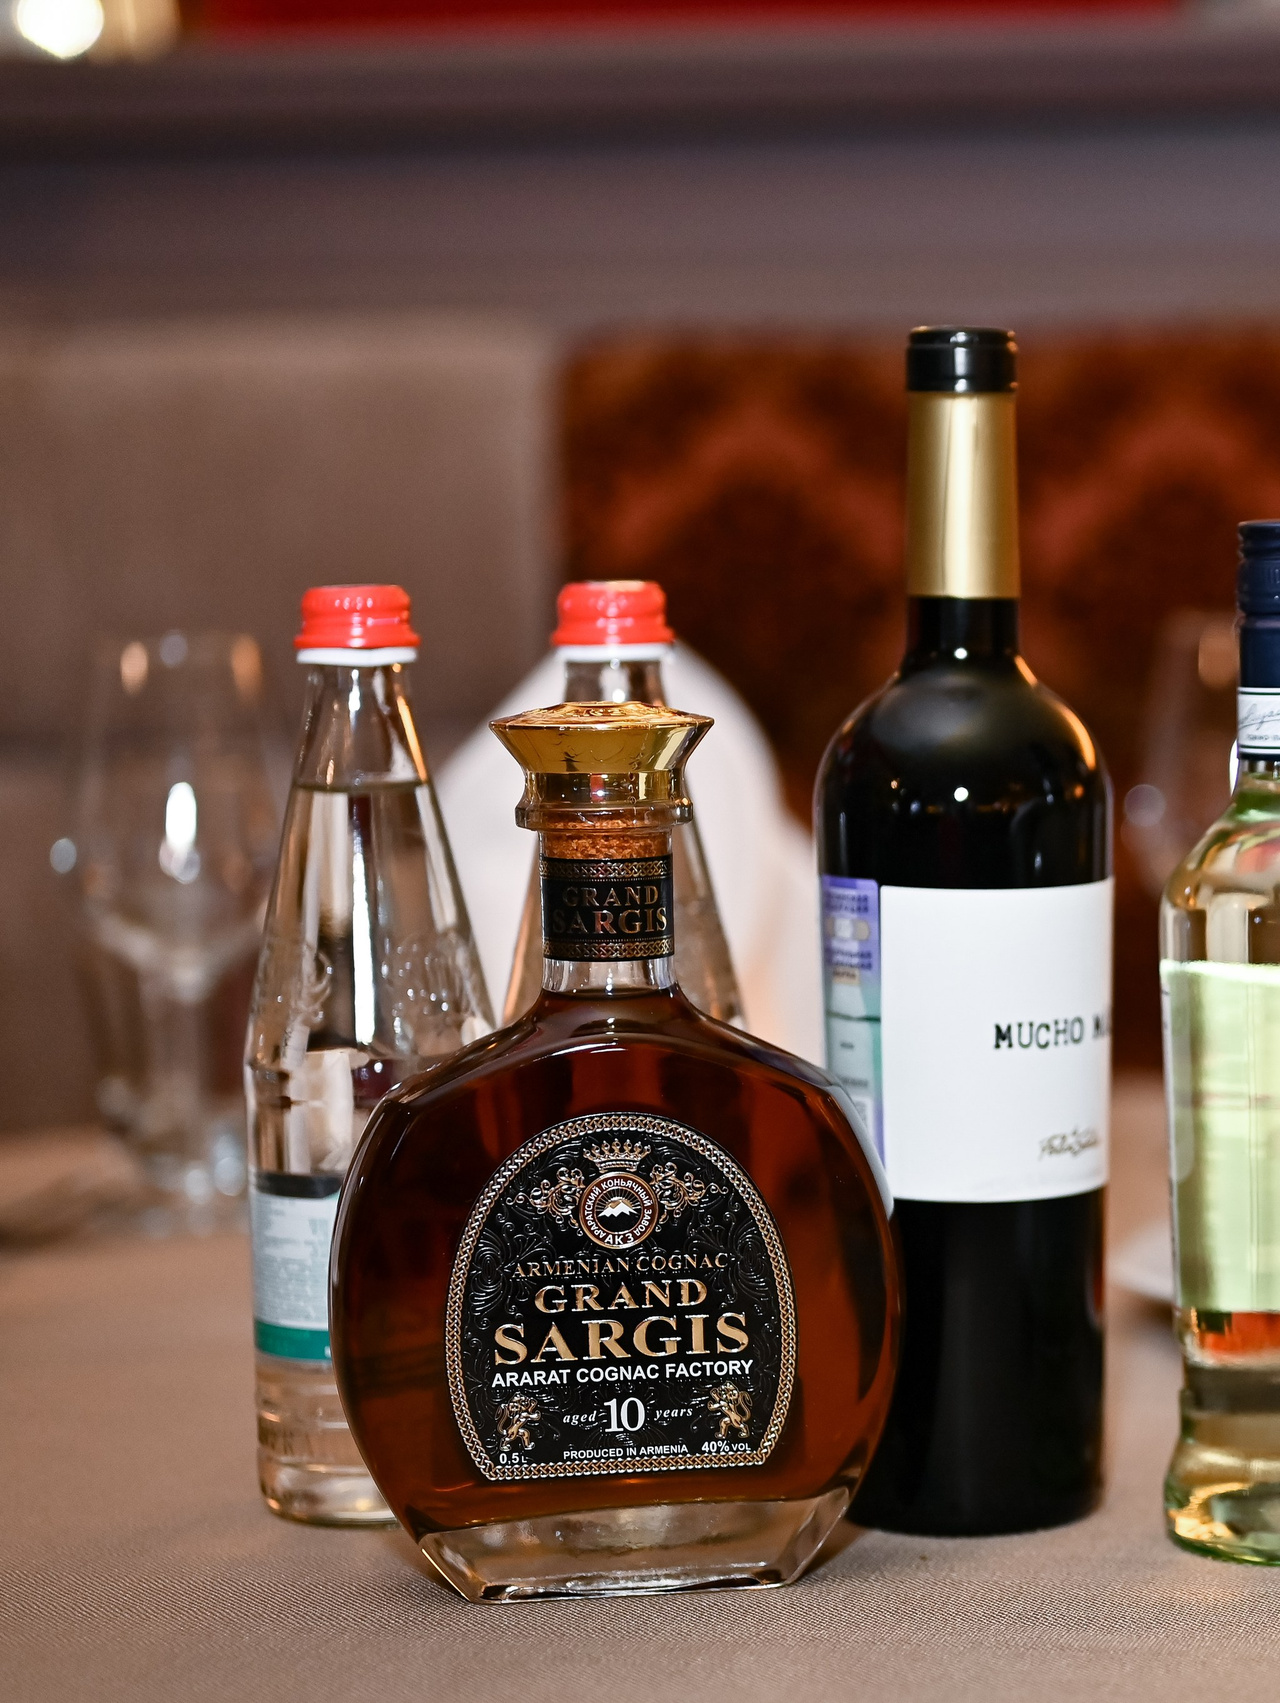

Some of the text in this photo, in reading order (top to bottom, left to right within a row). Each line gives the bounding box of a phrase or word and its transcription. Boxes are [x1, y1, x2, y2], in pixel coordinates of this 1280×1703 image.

[562, 885, 659, 907] GRAND
[552, 906, 667, 934] SARGIS
[994, 1016, 1084, 1049] MUCHO
[584, 1178, 653, 1239] АРАРАТСКИЙ КОНЬЯЧНЫЙ ЗАВОД
[511, 1252, 729, 1279] ARMENIAN COGNAC
[534, 1278, 708, 1314] GRAND
[494, 1311, 750, 1366] SARGIS
[491, 1359, 754, 1388] ARARAT COGNAC FACTORY
[562, 1397, 693, 1433] aged 10 years
[499, 1452, 520, 1467] 0,5
[563, 1444, 689, 1460] PRODUCED IN ARMENIA
[701, 1440, 751, 1453] 40% VOL
